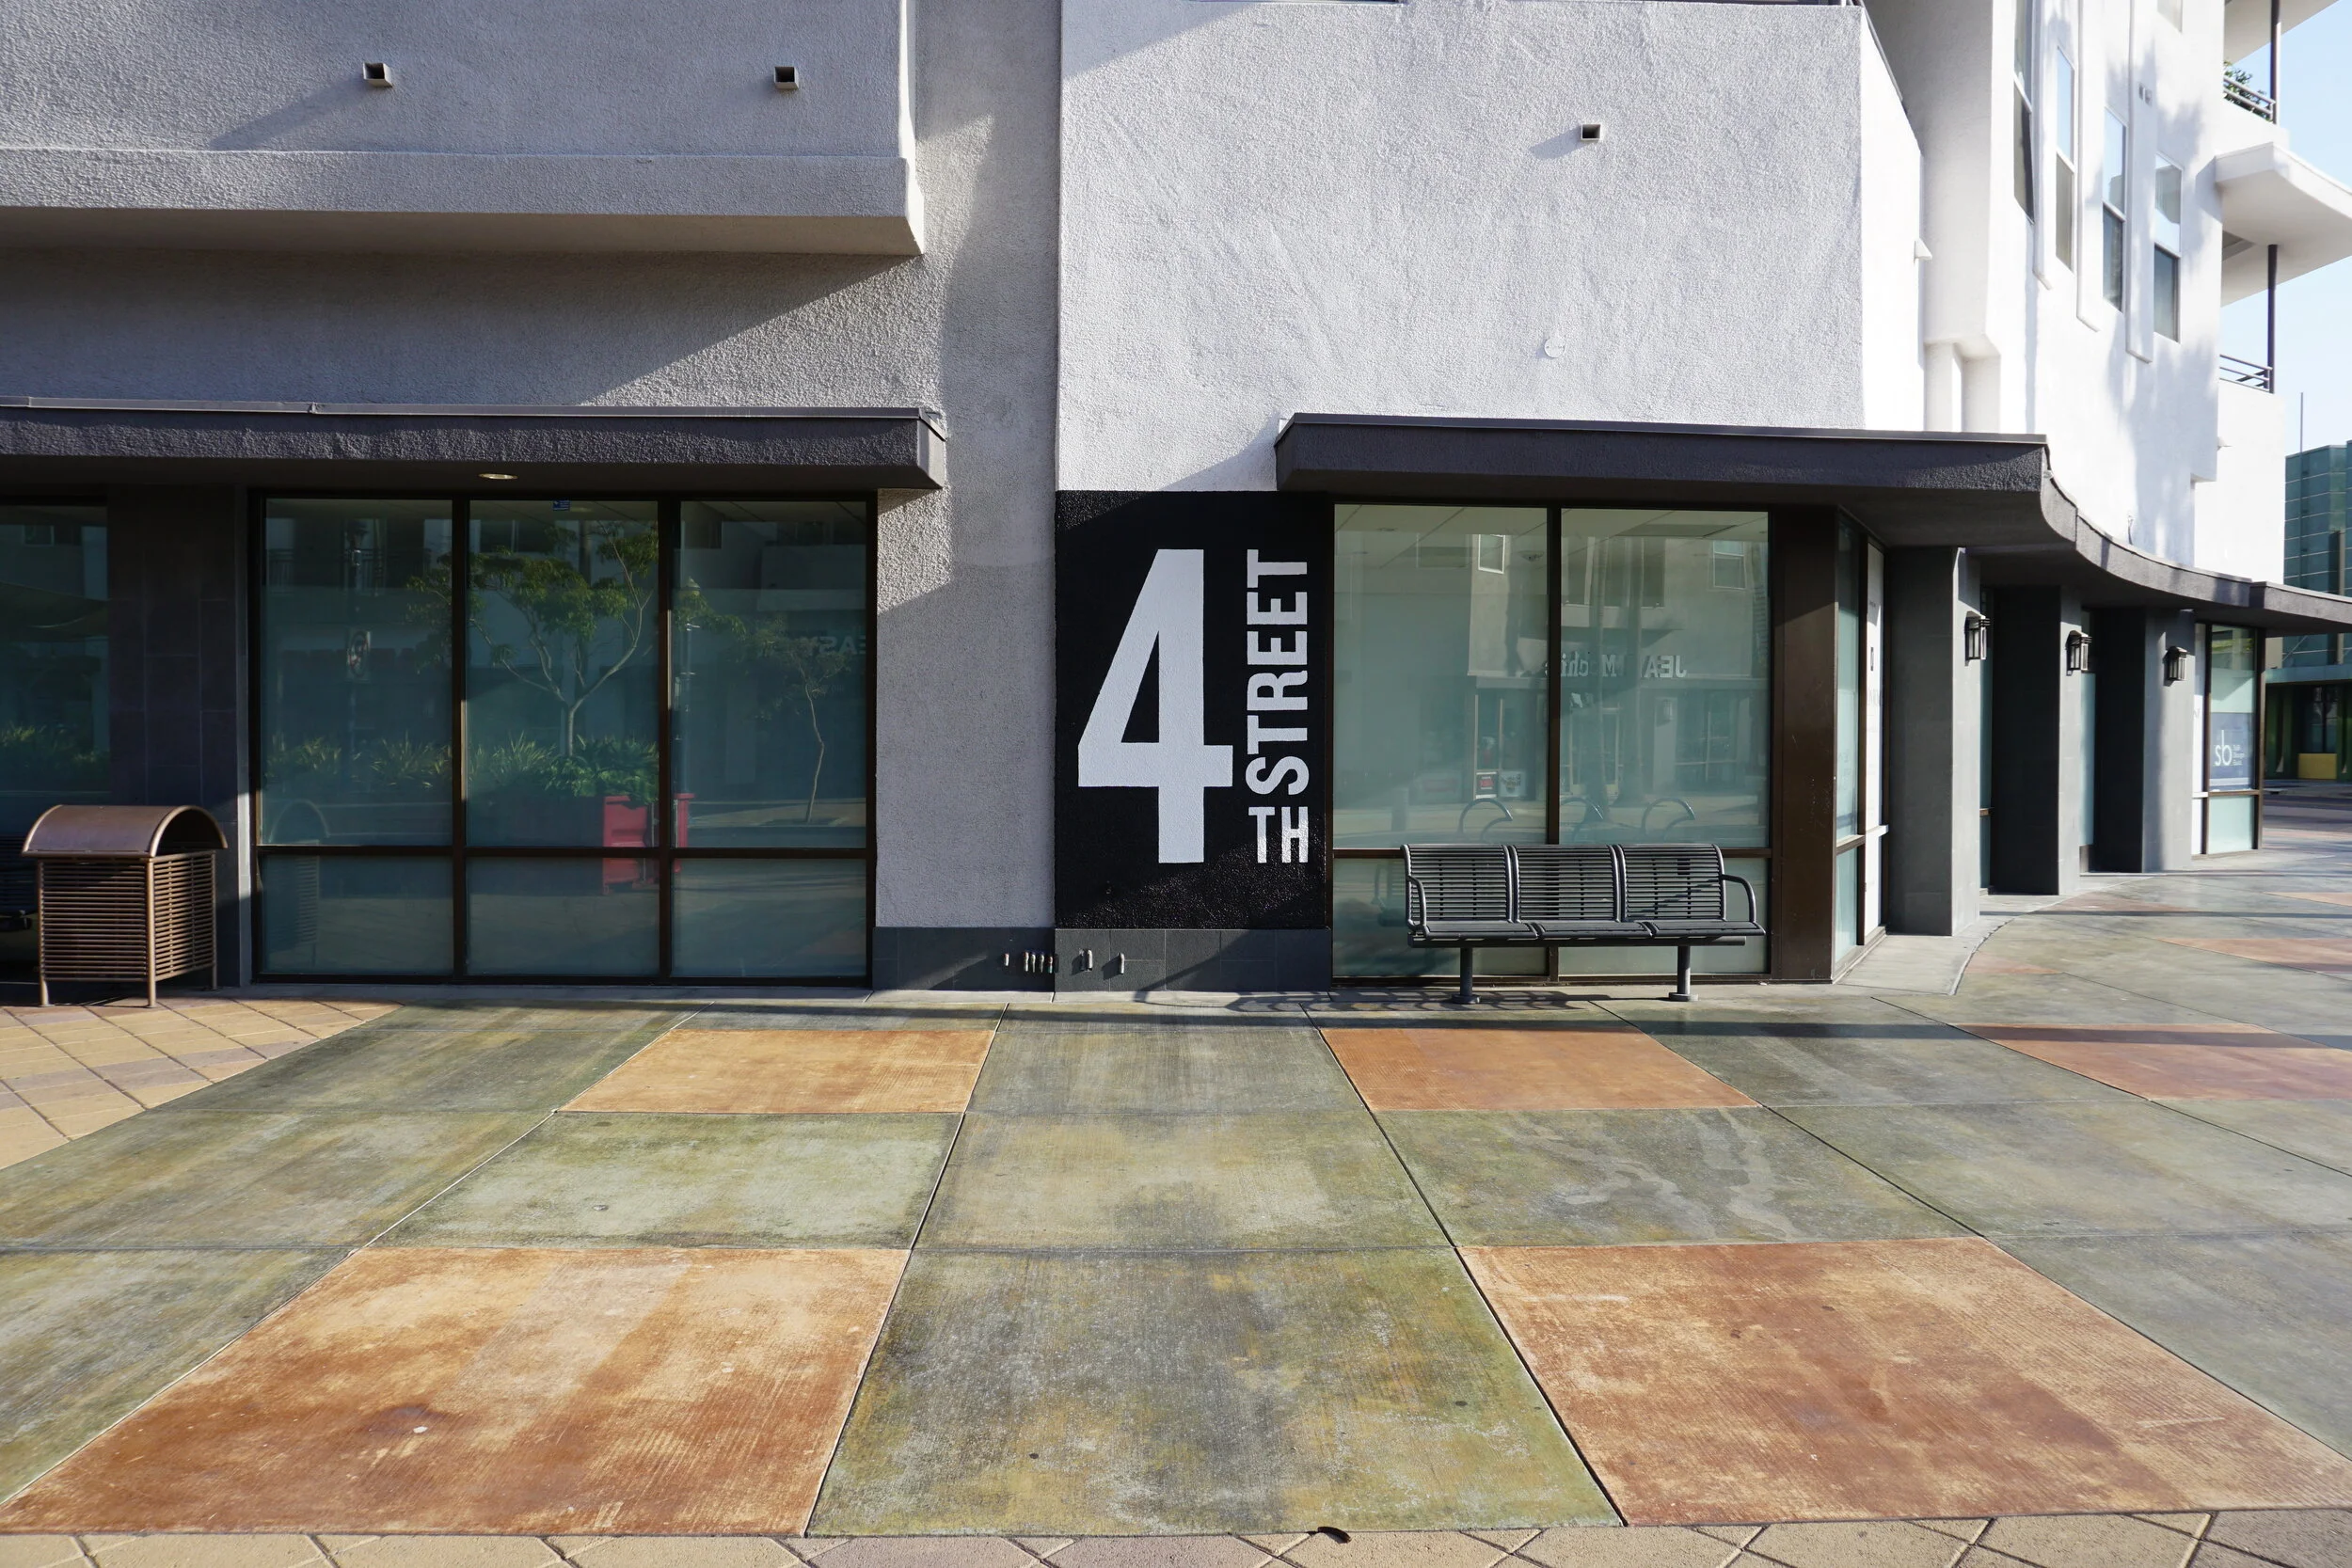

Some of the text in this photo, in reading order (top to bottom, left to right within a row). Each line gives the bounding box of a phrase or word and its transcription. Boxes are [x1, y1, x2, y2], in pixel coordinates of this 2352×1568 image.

[1078, 548, 1232, 863] 4
[1245, 548, 1310, 796] STREET
[2214, 729, 2233, 766] sb
[1248, 805, 1310, 863] TH
